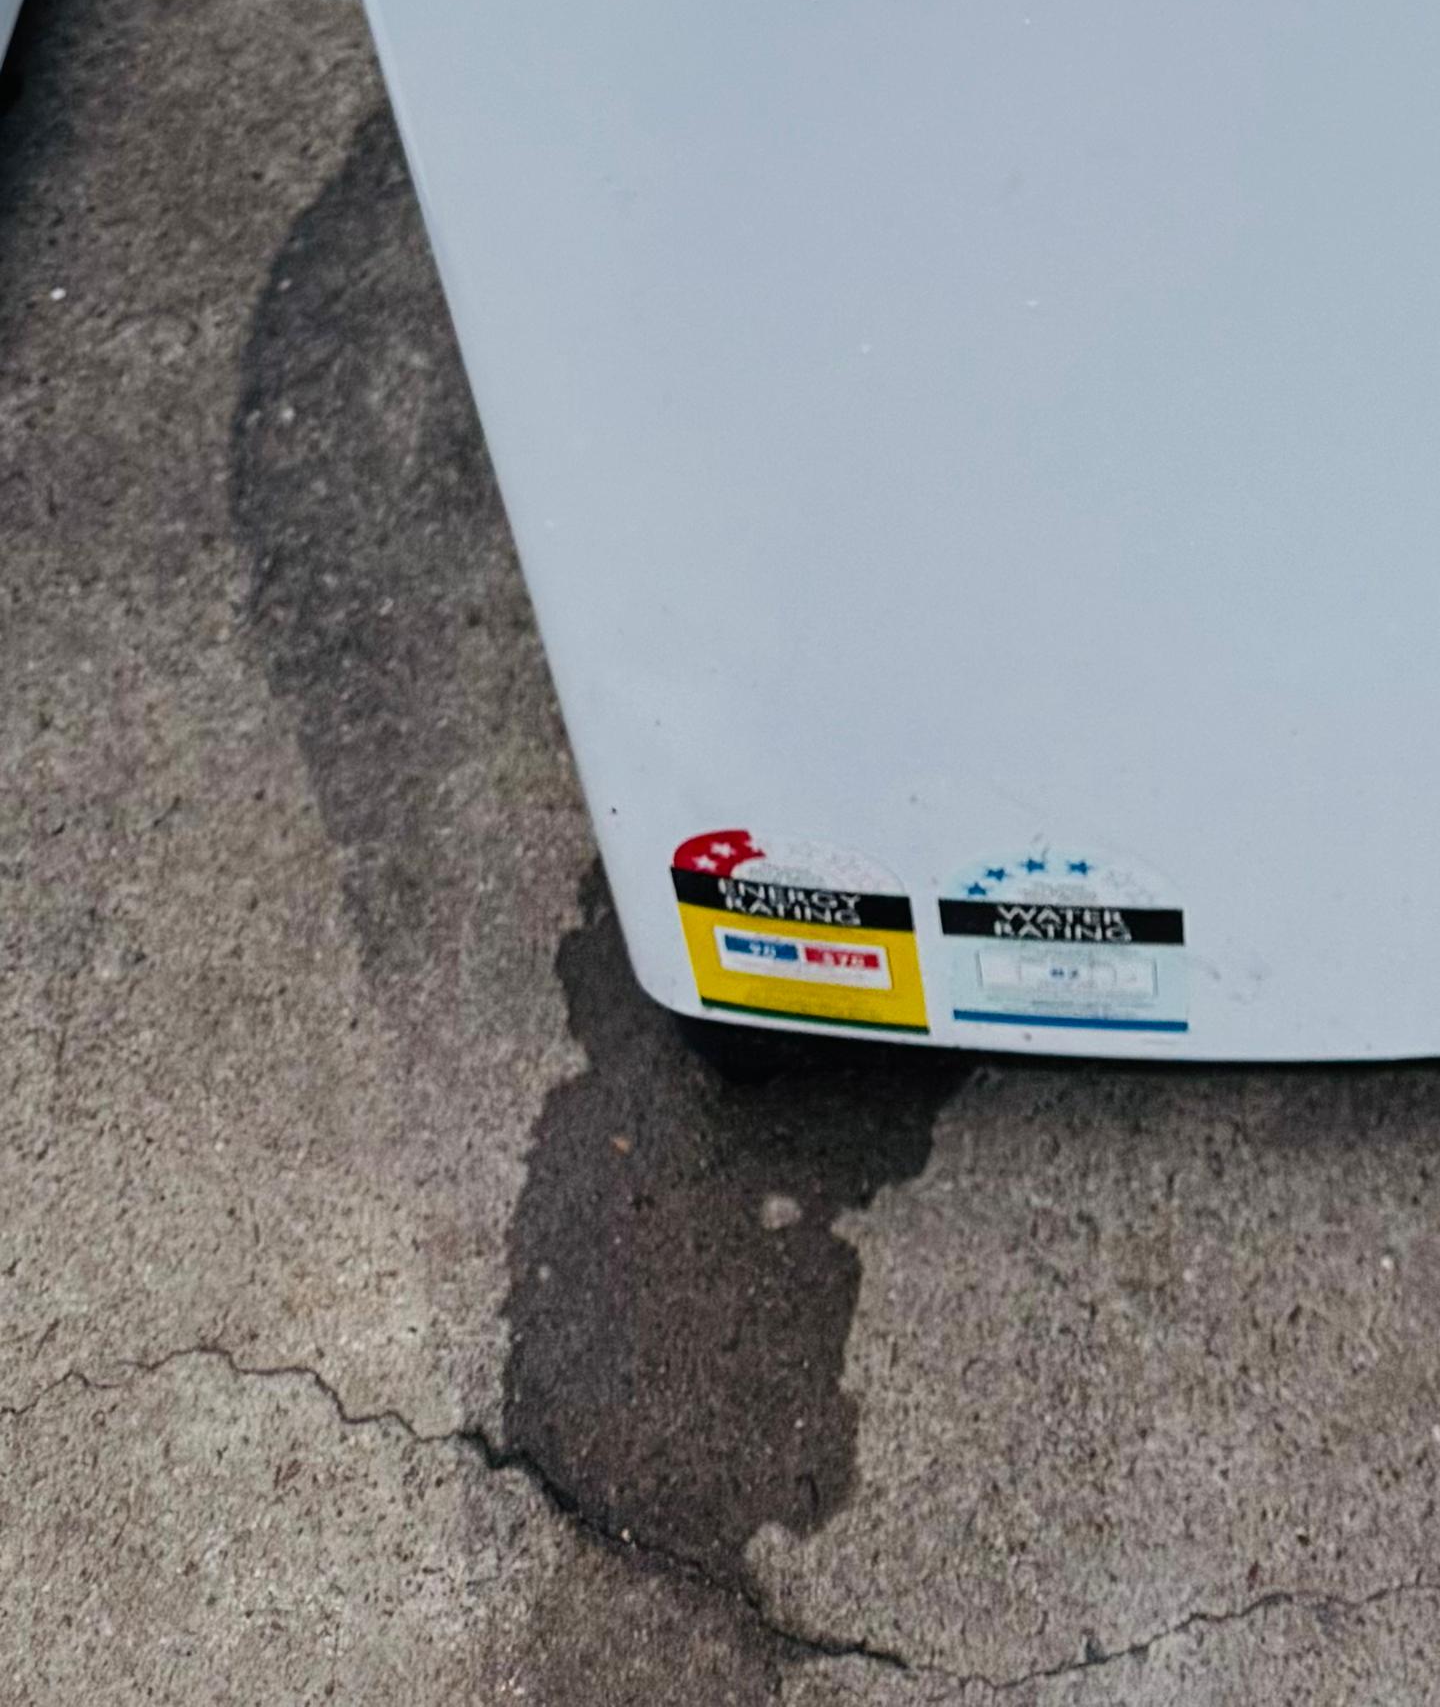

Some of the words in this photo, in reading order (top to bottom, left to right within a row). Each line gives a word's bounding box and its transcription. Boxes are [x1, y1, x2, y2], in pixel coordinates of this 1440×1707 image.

[718, 878, 861, 909] ENERGY
[725, 894, 862, 925] RATING
[998, 904, 1122, 924] WATER
[993, 919, 1132, 941] RATING
